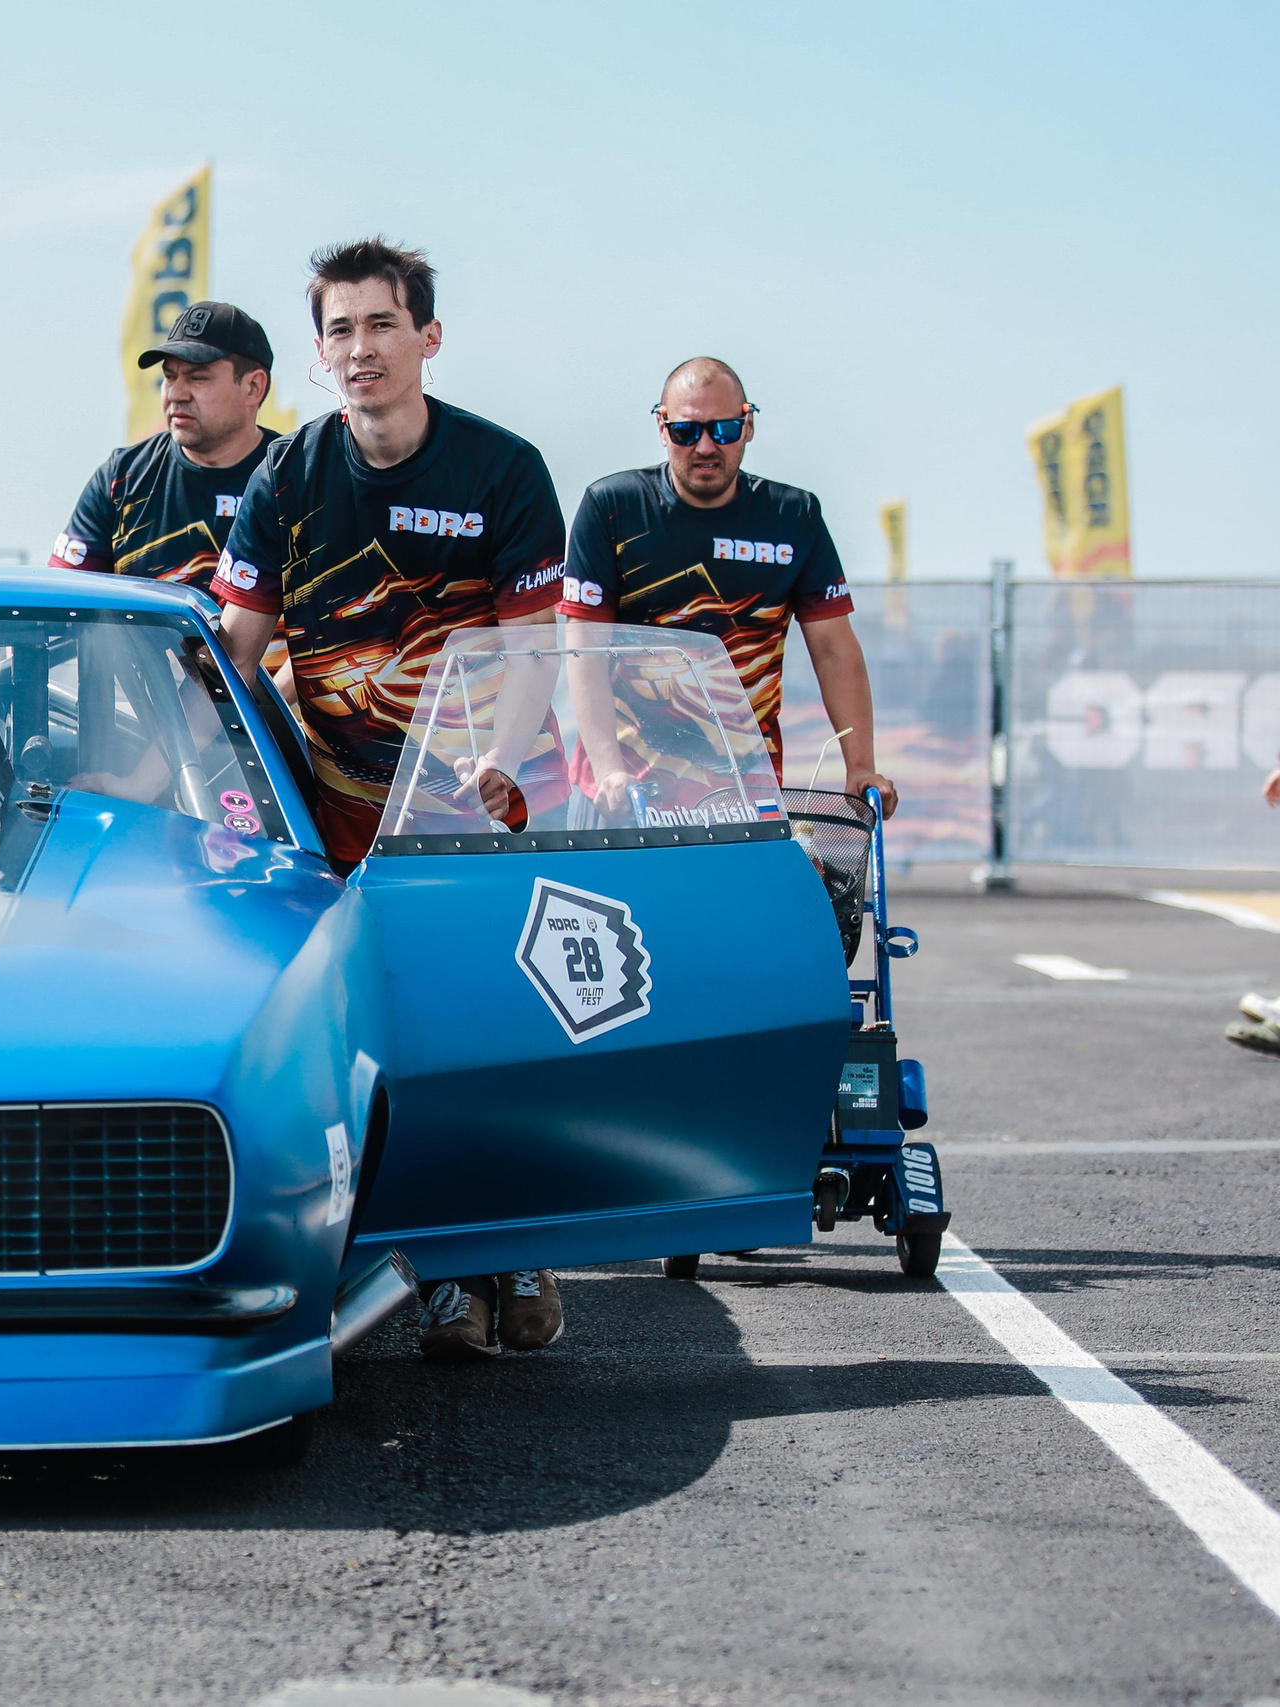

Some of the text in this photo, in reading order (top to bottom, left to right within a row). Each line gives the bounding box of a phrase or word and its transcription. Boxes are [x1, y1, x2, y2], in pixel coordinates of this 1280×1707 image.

[389, 506, 484, 538] RDRC
[713, 537, 794, 566] RDRC
[645, 802, 759, 829] Dmitry Lisin
[547, 918, 580, 931] RDRC
[562, 937, 604, 982] 28
[581, 997, 602, 1006] FEST
[901, 1147, 937, 1196] 1016
